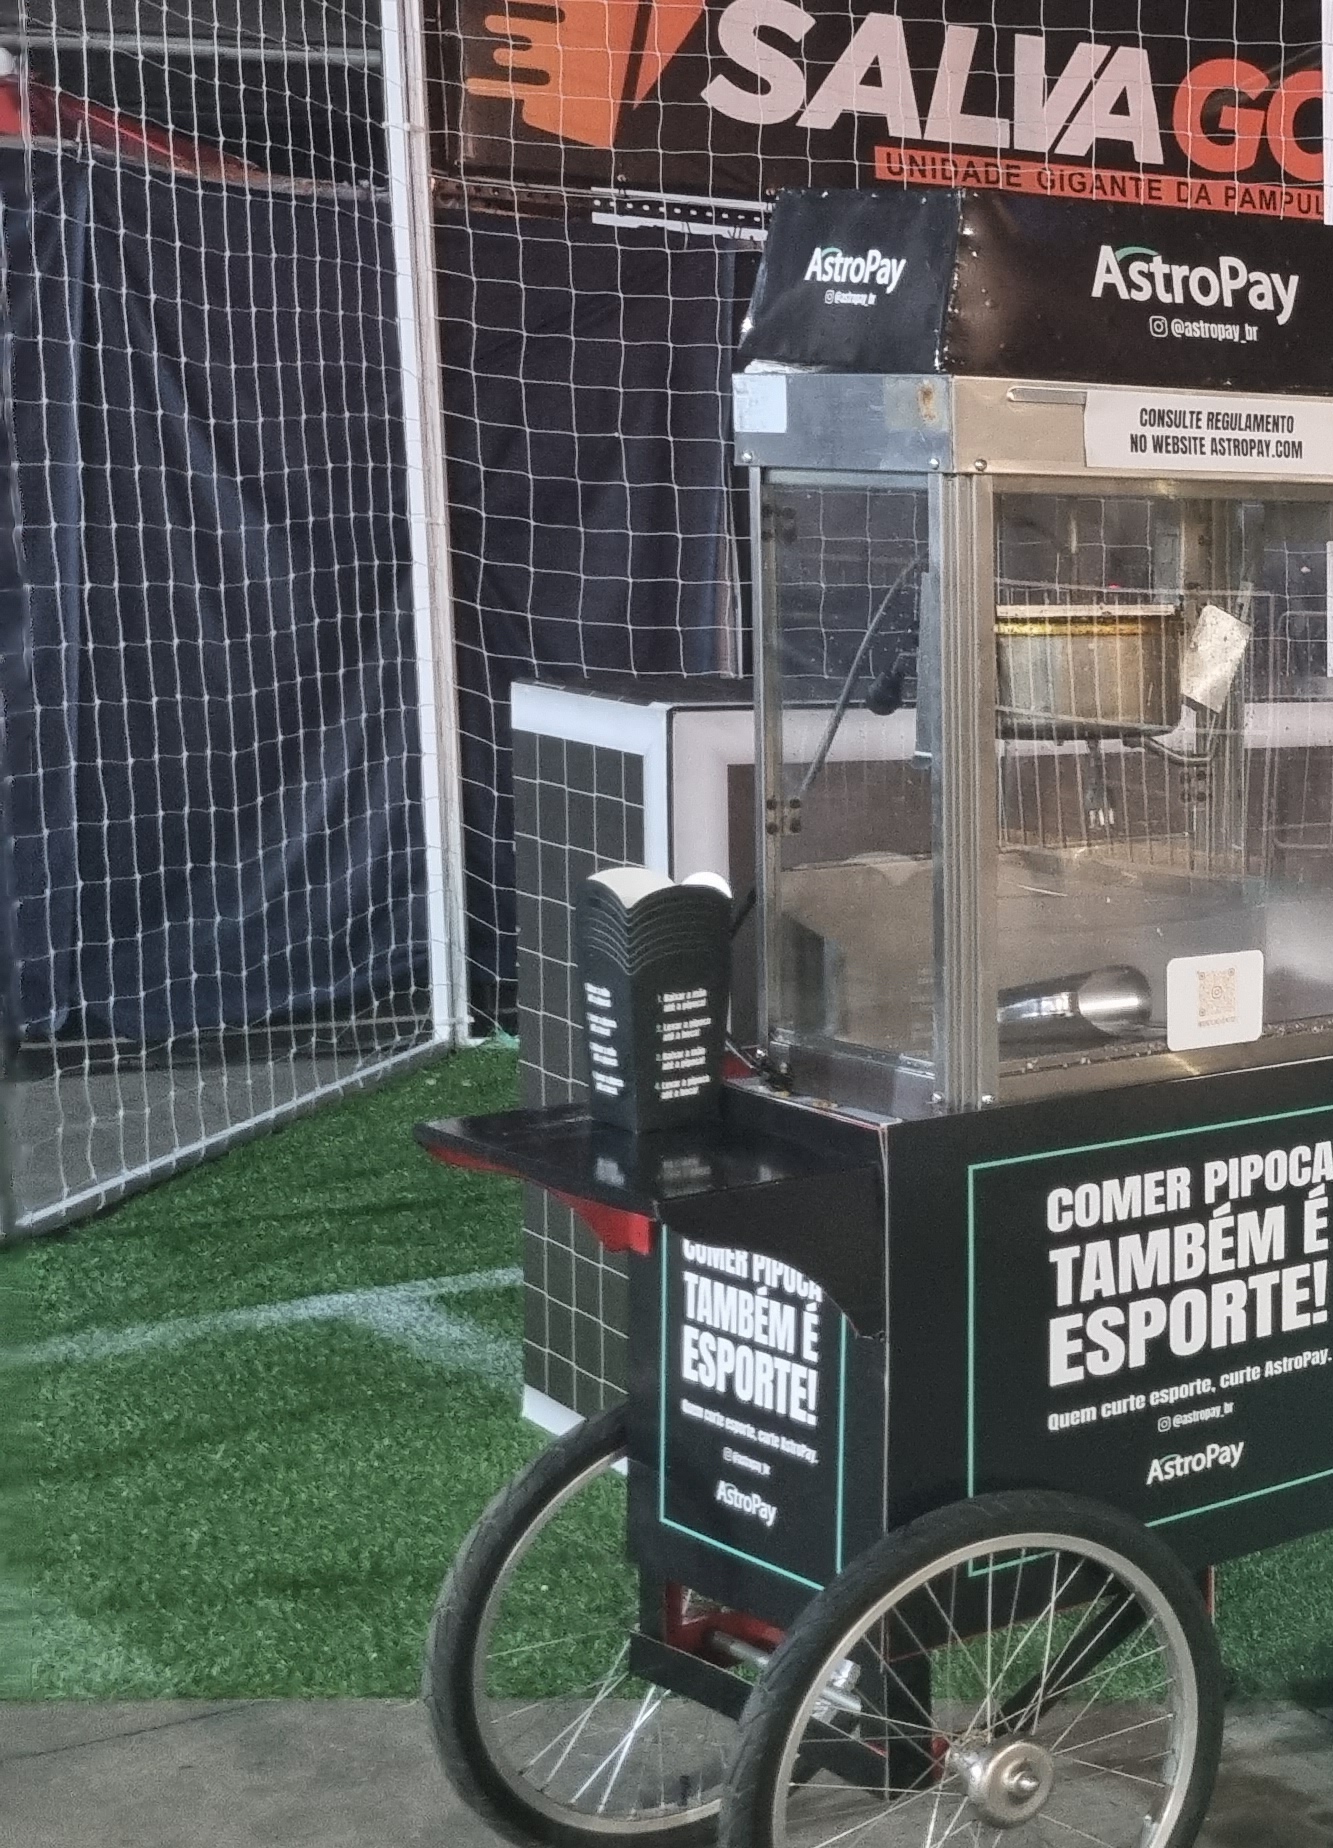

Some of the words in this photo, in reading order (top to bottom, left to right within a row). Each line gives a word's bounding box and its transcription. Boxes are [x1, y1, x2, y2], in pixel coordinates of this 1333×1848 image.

[701, 0, 1166, 164] SALVA
[886, 151, 1022, 187] UNIDADE
[1036, 165, 1162, 201] GIGANTE
[1177, 181, 1212, 207] DA
[804, 247, 906, 294] AstroPay
[1091, 245, 1299, 326] AstroPay
[1171, 318, 1259, 344] @astropay_br
[1130, 433, 1147, 453] NO
[1152, 435, 1206, 456] WEBSITE
[1210, 437, 1303, 460] ASTROPAY.COM
[1139, 407, 1203, 430] CONSULTE
[1206, 411, 1295, 434] REGULAMENTO
[1047, 1167, 1191, 1233] COMER
[1049, 1201, 1286, 1308] TAMBÉM
[1304, 1182, 1330, 1254] É
[683, 1270, 796, 1355] TAMBÉM
[802, 1301, 820, 1363] É
[1049, 1259, 1329, 1388] ESPORTE!
[682, 1324, 819, 1426] ESPORTE!
[1048, 1407, 1097, 1430] Quem
[1101, 1391, 1147, 1418] curte
[1150, 1377, 1216, 1406] esporte,
[1219, 1366, 1261, 1389] curte
[1264, 1348, 1333, 1378] AstroPay.
[1172, 1402, 1235, 1427] @astropay_br
[1146, 1442, 1245, 1485] AstroPay
[715, 1479, 778, 1527] AstroPay
